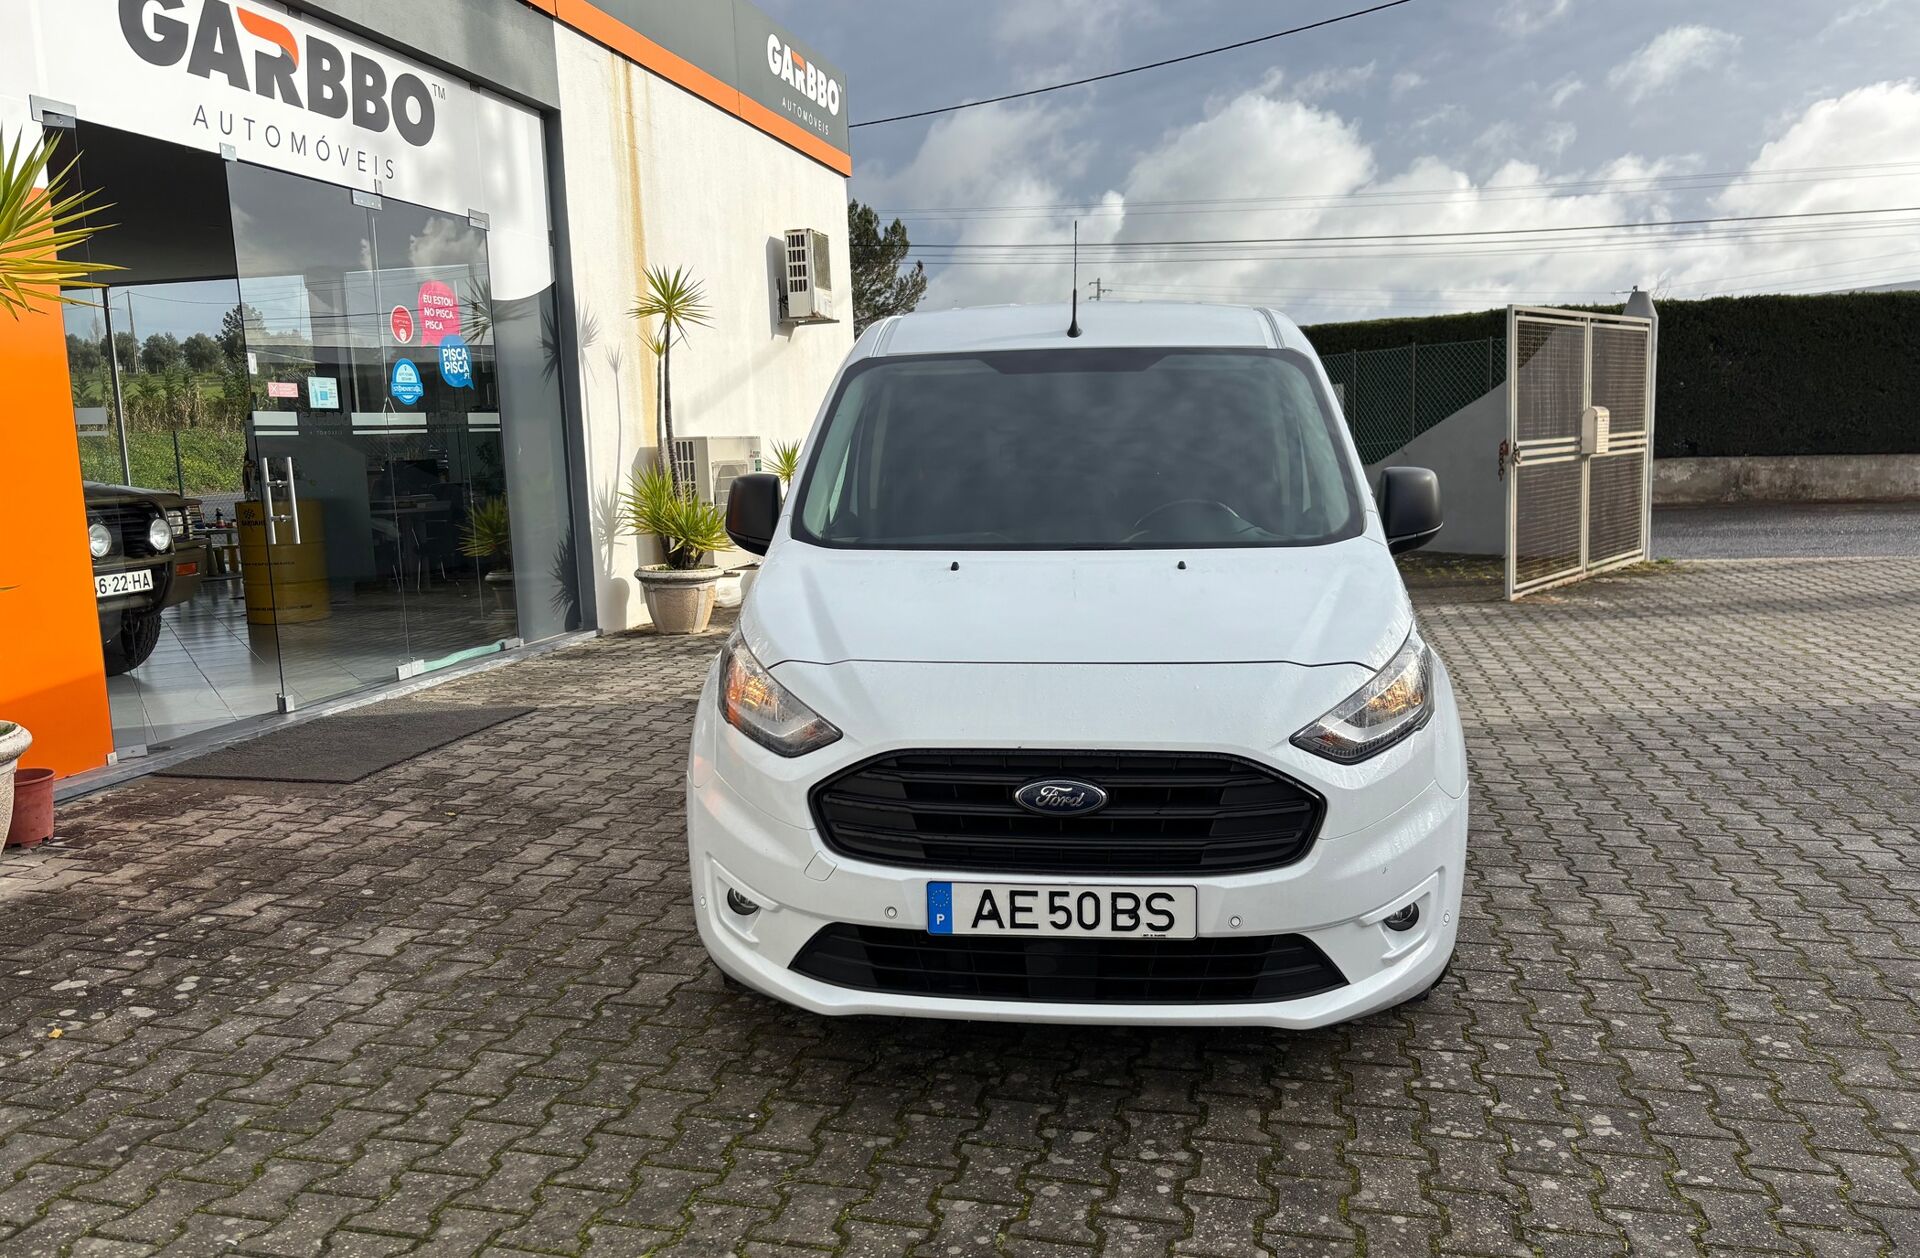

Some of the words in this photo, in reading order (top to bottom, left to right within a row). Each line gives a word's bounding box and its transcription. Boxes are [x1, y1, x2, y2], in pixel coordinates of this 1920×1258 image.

[118, 0, 436, 147] GARBBO
[767, 33, 840, 116] GARBBO
[192, 104, 395, 180] AUTOMÓVEIS
[423, 294, 433, 303] EU
[433, 296, 454, 307] ESTOU
[424, 307, 435, 316] NO
[435, 309, 454, 319] PISCA
[425, 320, 444, 330] PISCA
[1035, 785, 1086, 808] Ford
[936, 914, 945, 925] P
